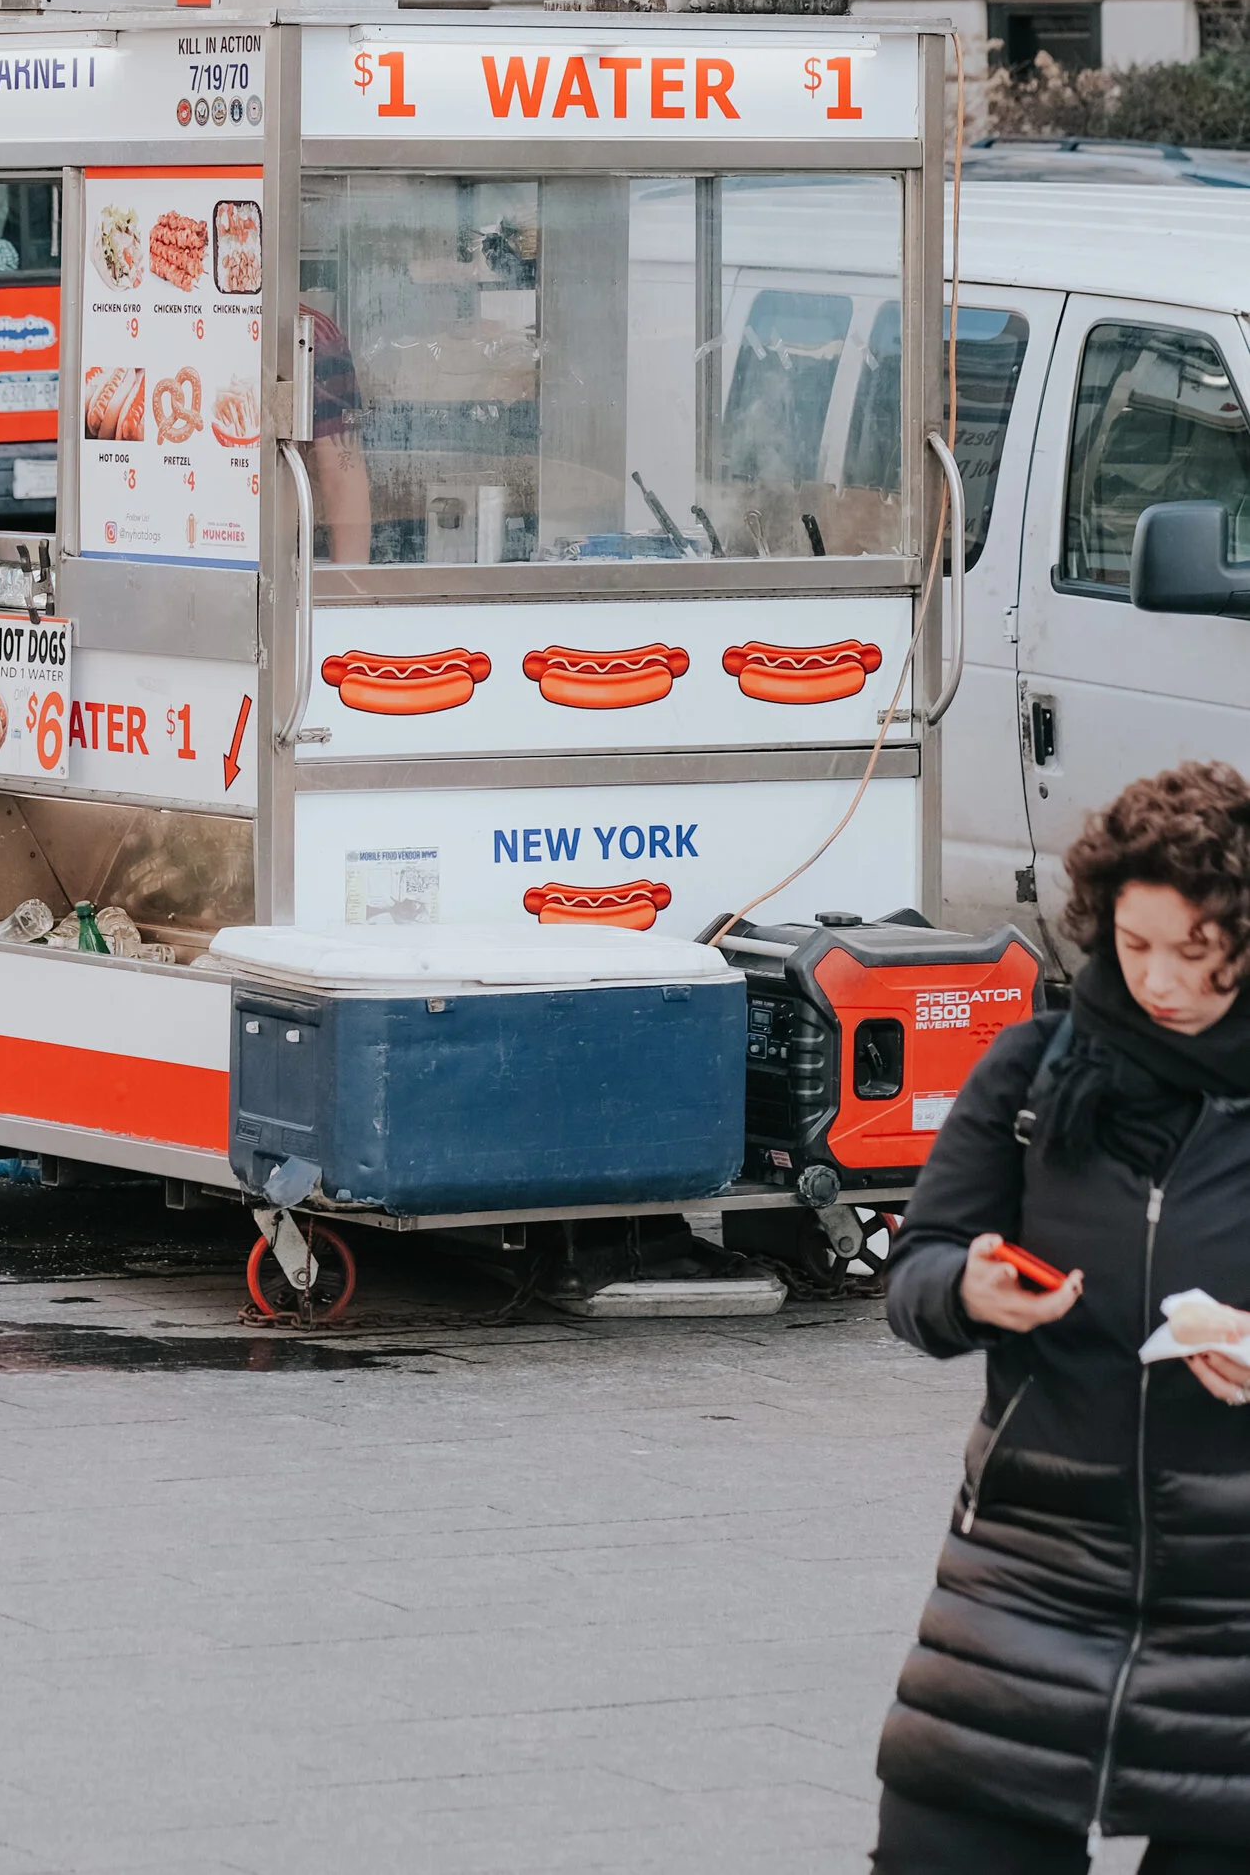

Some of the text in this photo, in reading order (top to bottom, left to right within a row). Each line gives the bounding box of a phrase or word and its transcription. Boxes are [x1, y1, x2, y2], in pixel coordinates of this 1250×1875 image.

[178, 34, 261, 55] KILL IN ACTION
[189, 63, 249, 93] 7/19/70
[353, 50, 863, 120] $1 WATER $1
[92, 303, 142, 313] CHICKEN GYRO
[153, 304, 203, 314] CHICKEN STICK
[212, 304, 241, 315] CHICKEN
[125, 317, 139, 338] $9
[191, 318, 204, 340] $6
[246, 320, 259, 341] $9
[99, 453, 130, 464] HOT DOG
[163, 456, 191, 466] PRETZEL
[230, 458, 250, 468] FRIES
[123, 468, 137, 489] $3
[182, 471, 196, 492] $4
[246, 474, 259, 495] $5
[118, 526, 162, 544] @nyhotdogs
[202, 529, 246, 542] MUNCHIES
[27, 628, 66, 666] DOGS
[28, 668, 64, 682] WATER
[25, 690, 65, 771] $6
[69, 700, 196, 760] ATER $1
[493, 823, 699, 863] NEW YORK
[359, 851, 381, 861] MOBILE
[382, 851, 397, 861] FOOD
[397, 850, 421, 861] VENDOR
[915, 988, 1022, 1006] PREDATOR
[915, 1004, 971, 1022] 3500
[915, 1019, 971, 1030] INVERTER
